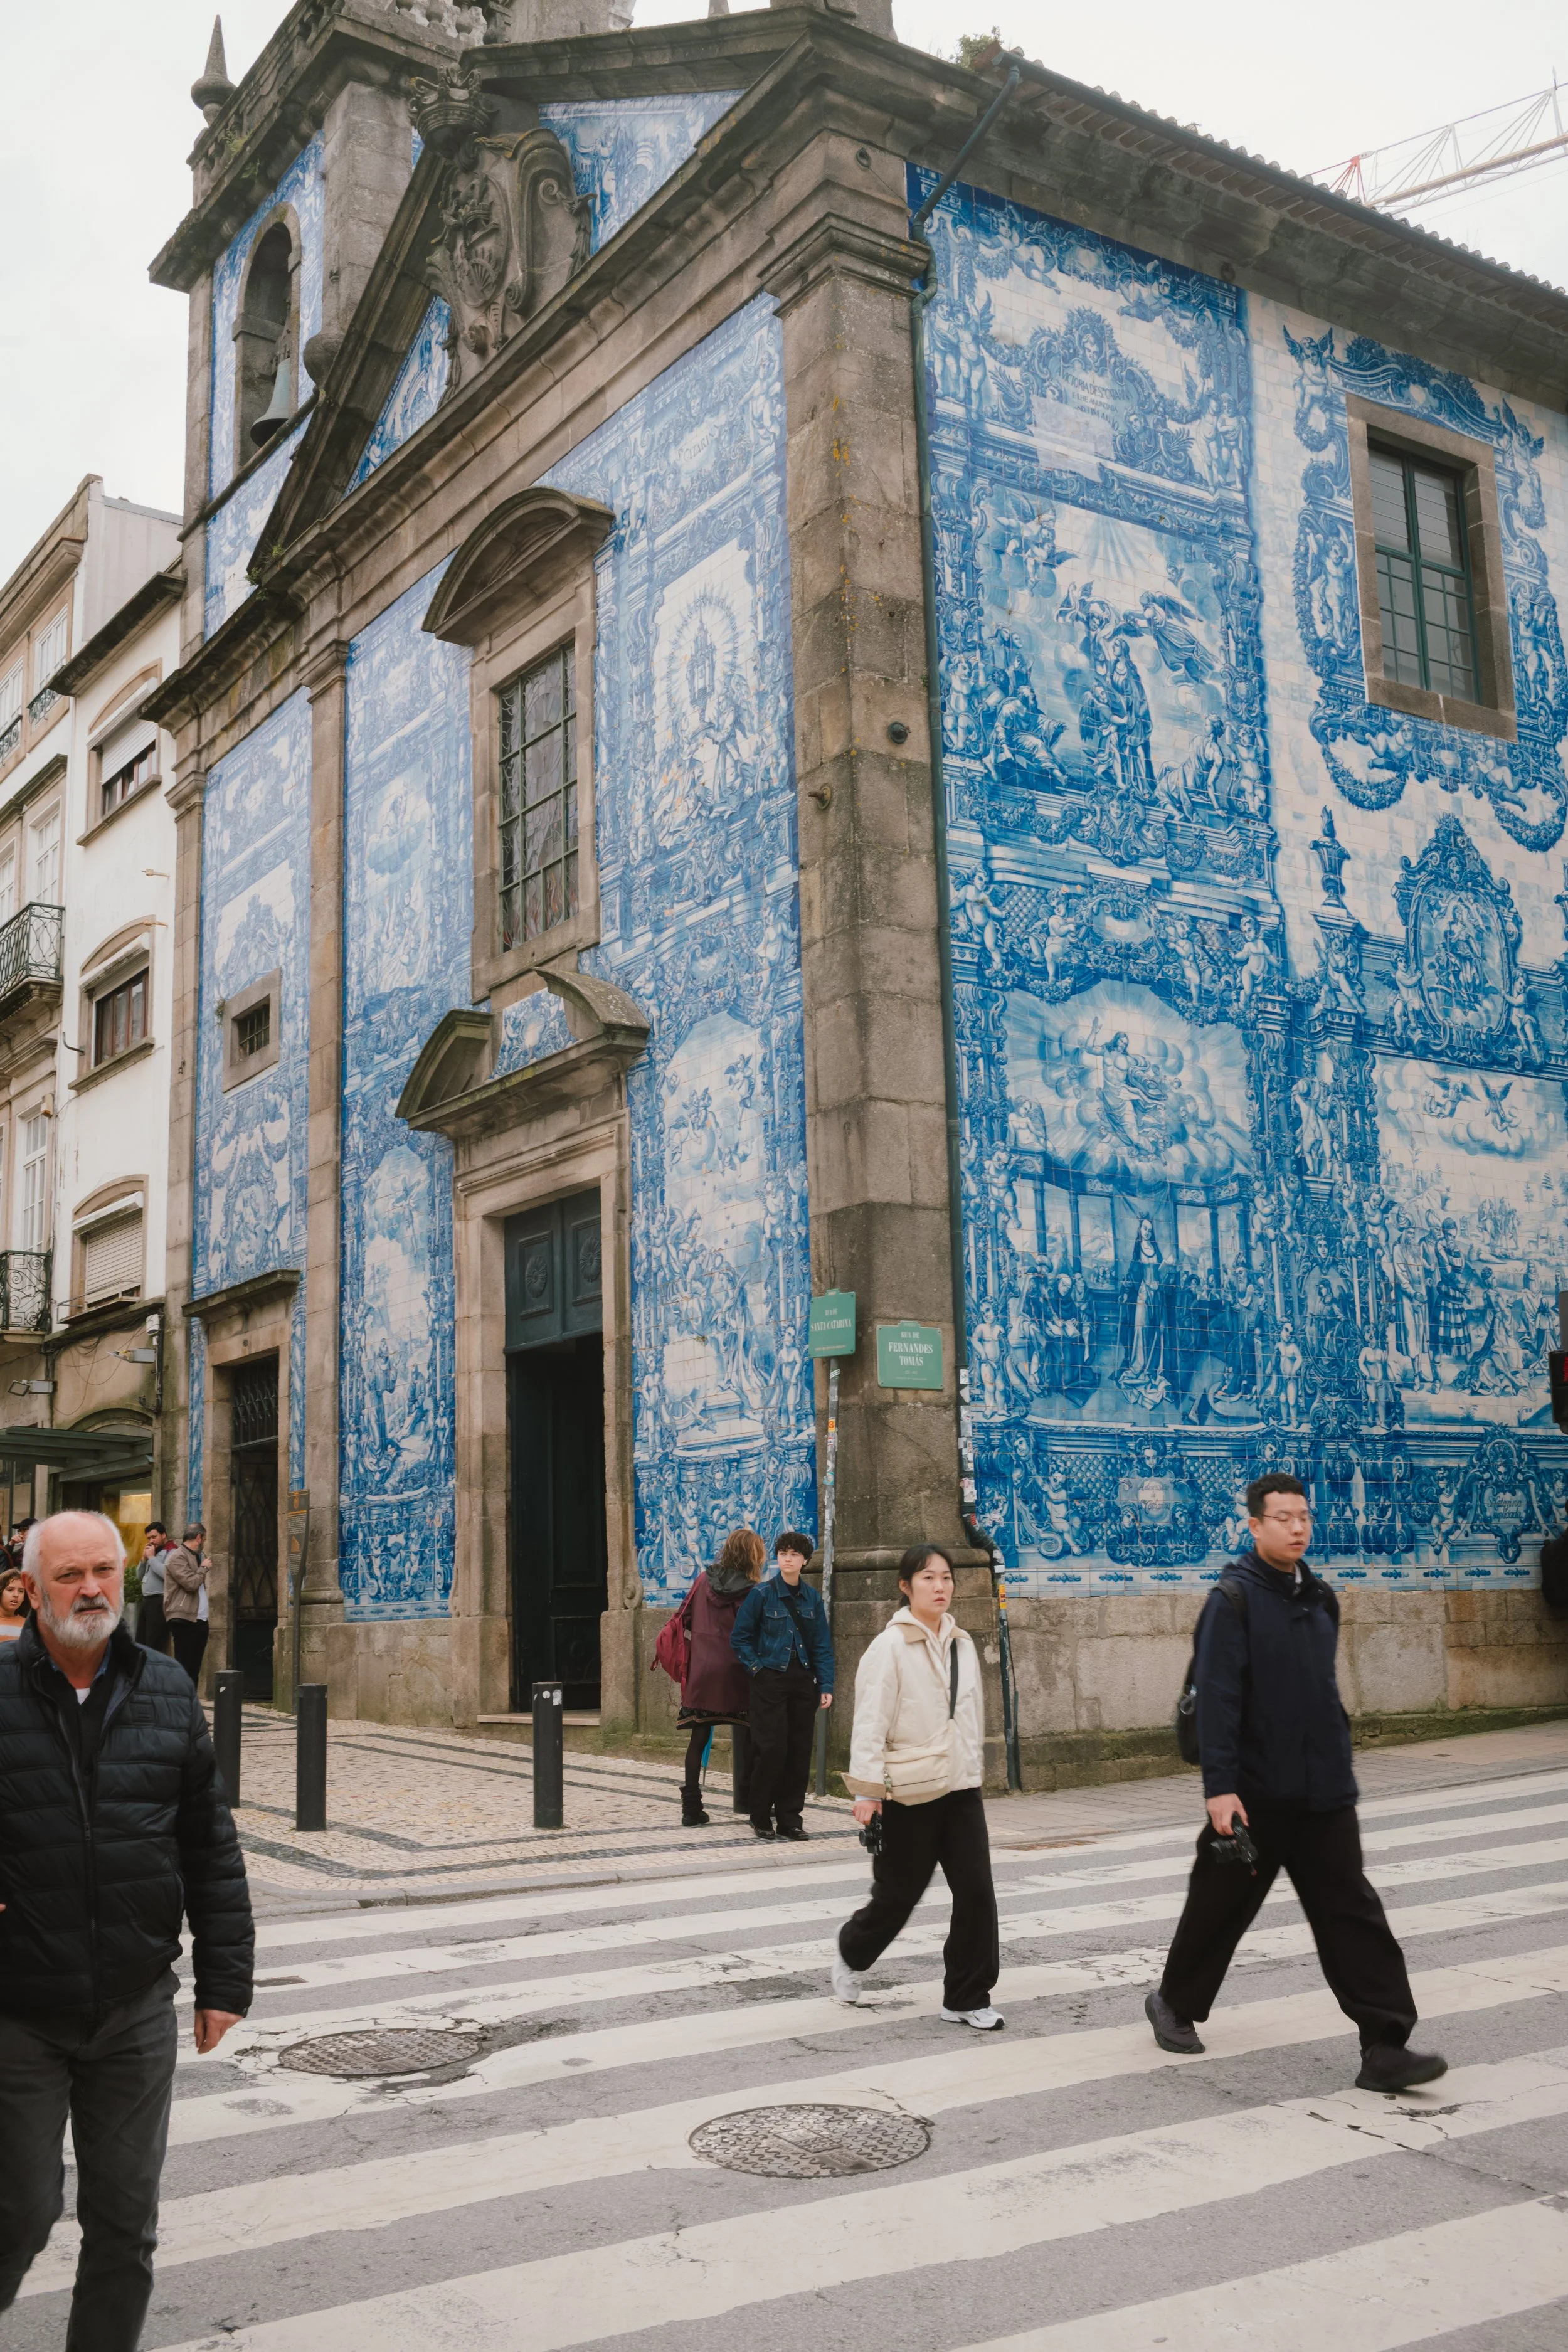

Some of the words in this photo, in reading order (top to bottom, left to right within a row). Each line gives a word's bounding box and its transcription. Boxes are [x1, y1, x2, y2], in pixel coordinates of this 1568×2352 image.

[811, 1322, 826, 1332] SANTA
[827, 1318, 852, 1330] CATARINA
[888, 1342, 933, 1354] FERNANDES
[899, 1354, 924, 1366] TOMÁS
